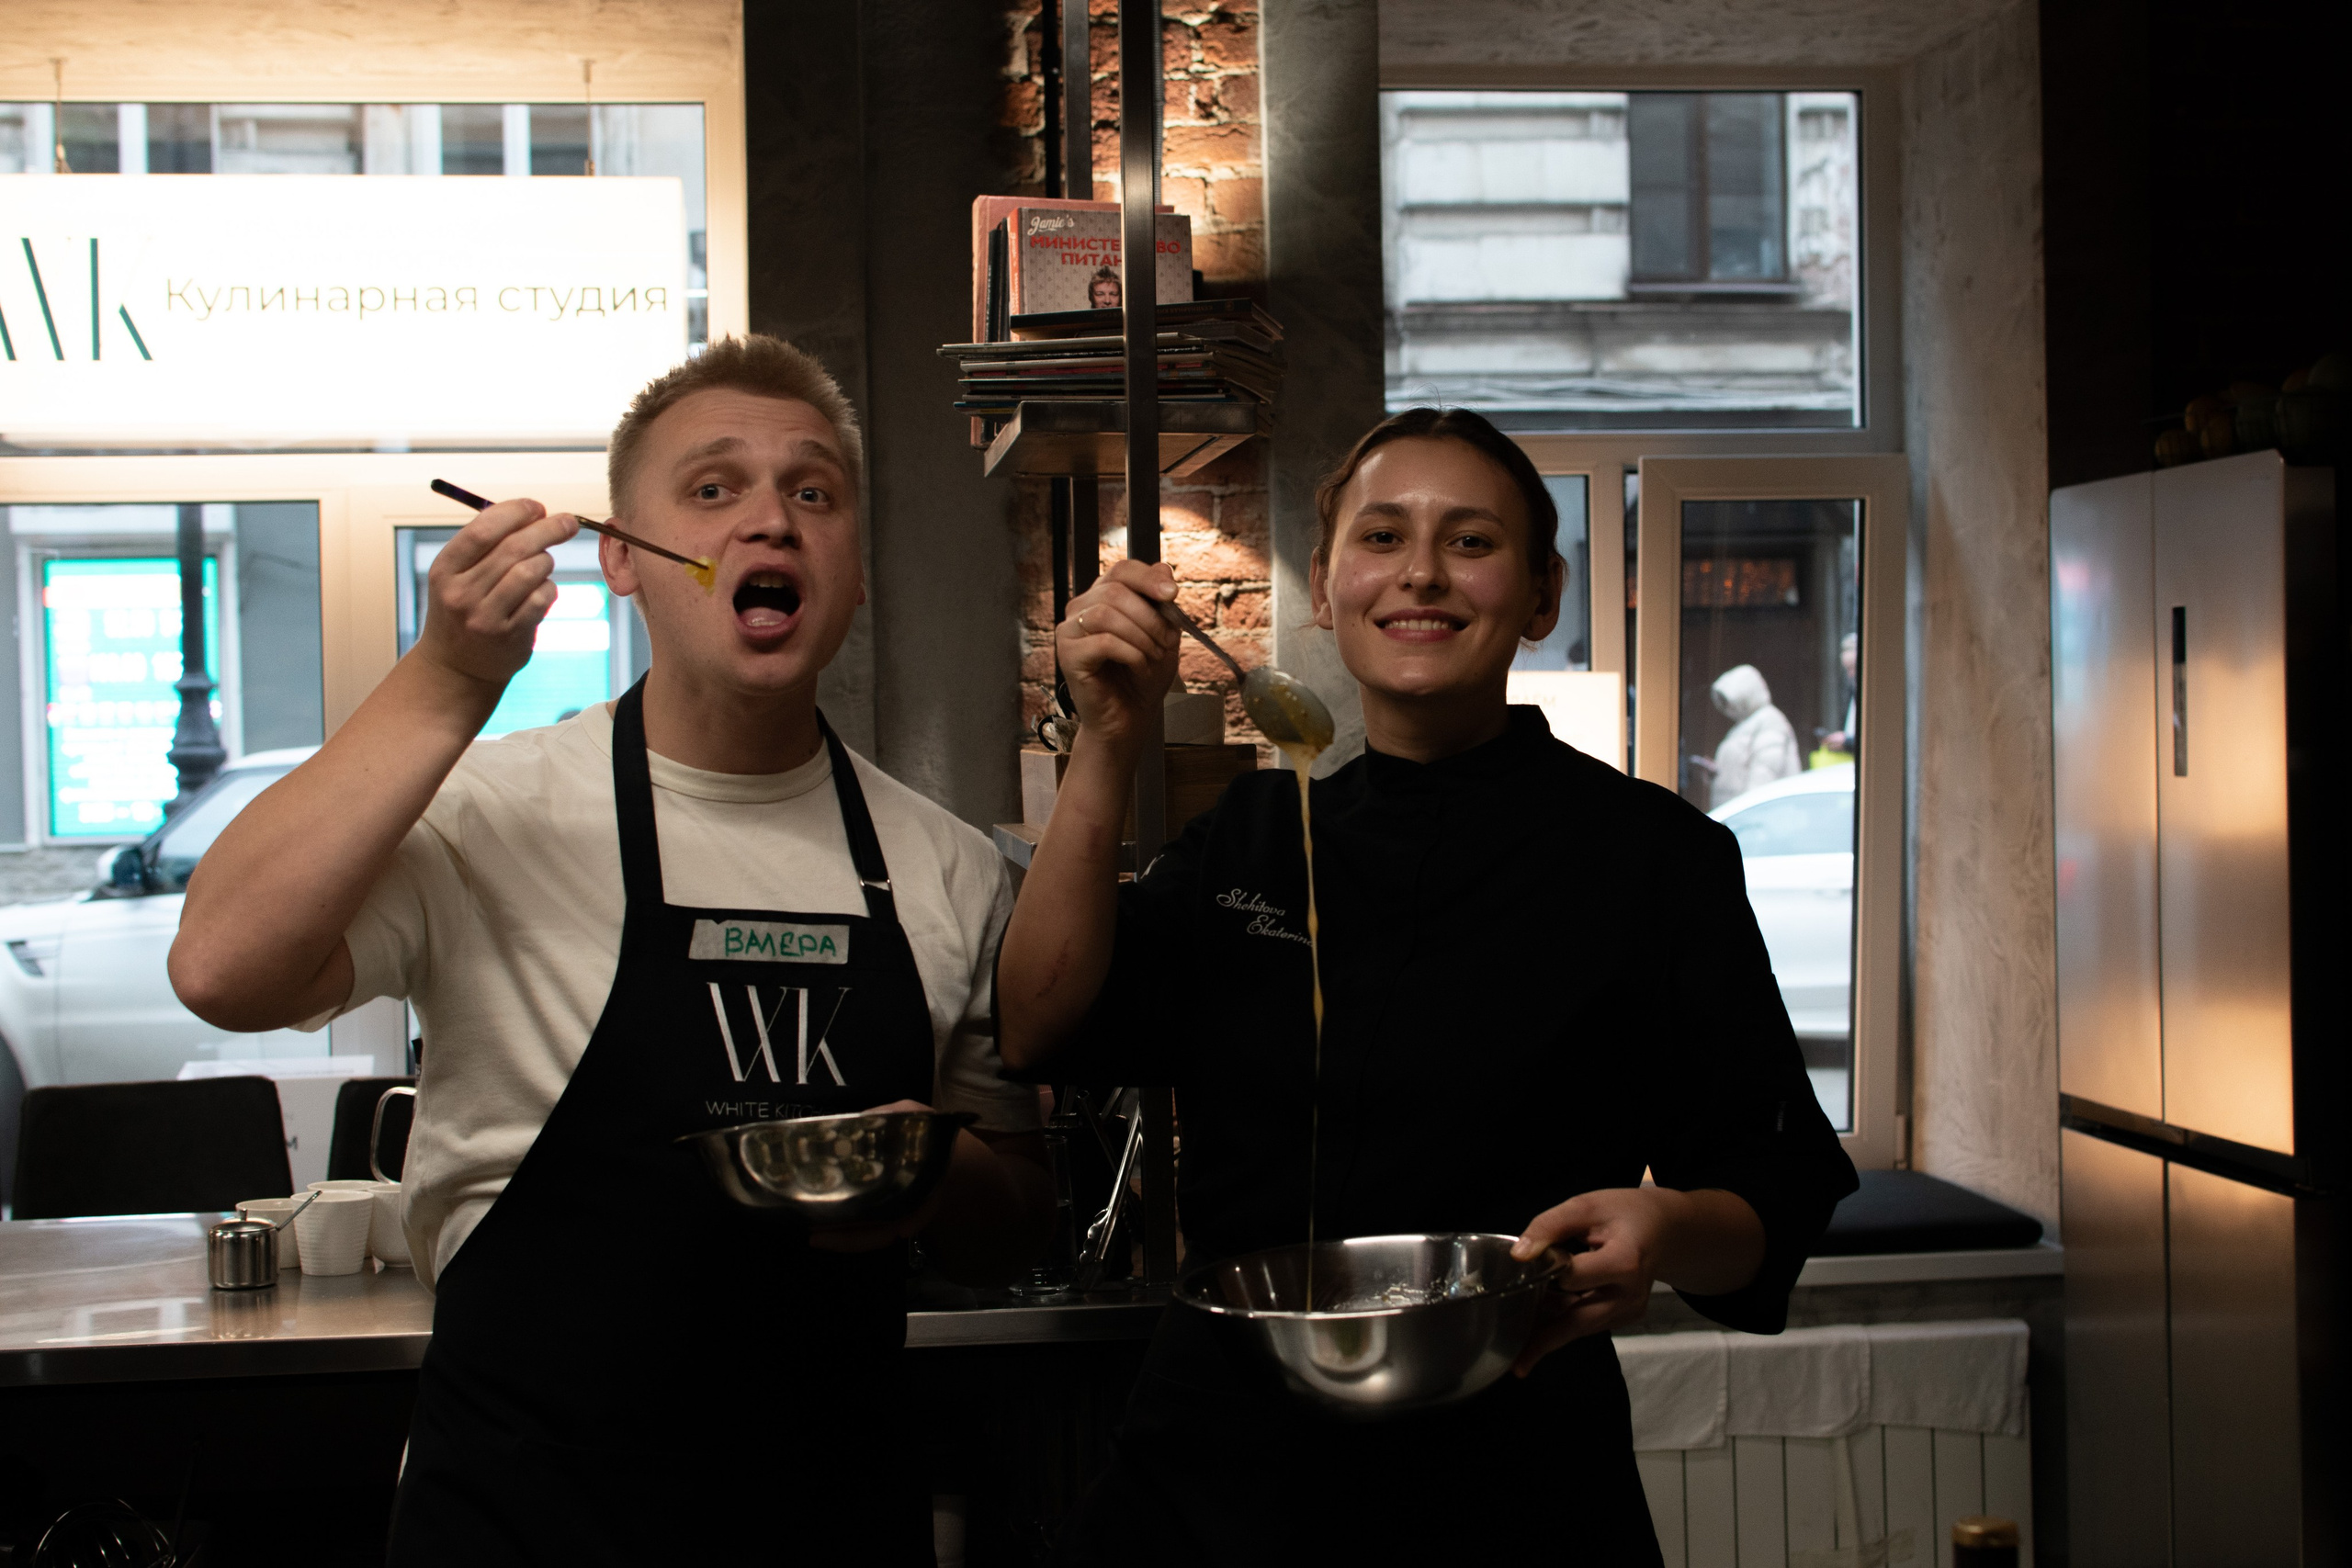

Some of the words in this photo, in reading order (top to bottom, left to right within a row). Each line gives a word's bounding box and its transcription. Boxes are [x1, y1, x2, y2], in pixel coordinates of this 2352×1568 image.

[1027, 214, 1075, 236] Jamie's
[1030, 236, 1182, 254] МИНИСТЕВО
[167, 278, 477, 321] Кулинарная
[498, 287, 668, 321] студия
[707, 982, 854, 1088] WK
[706, 1100, 769, 1118] WHITE
